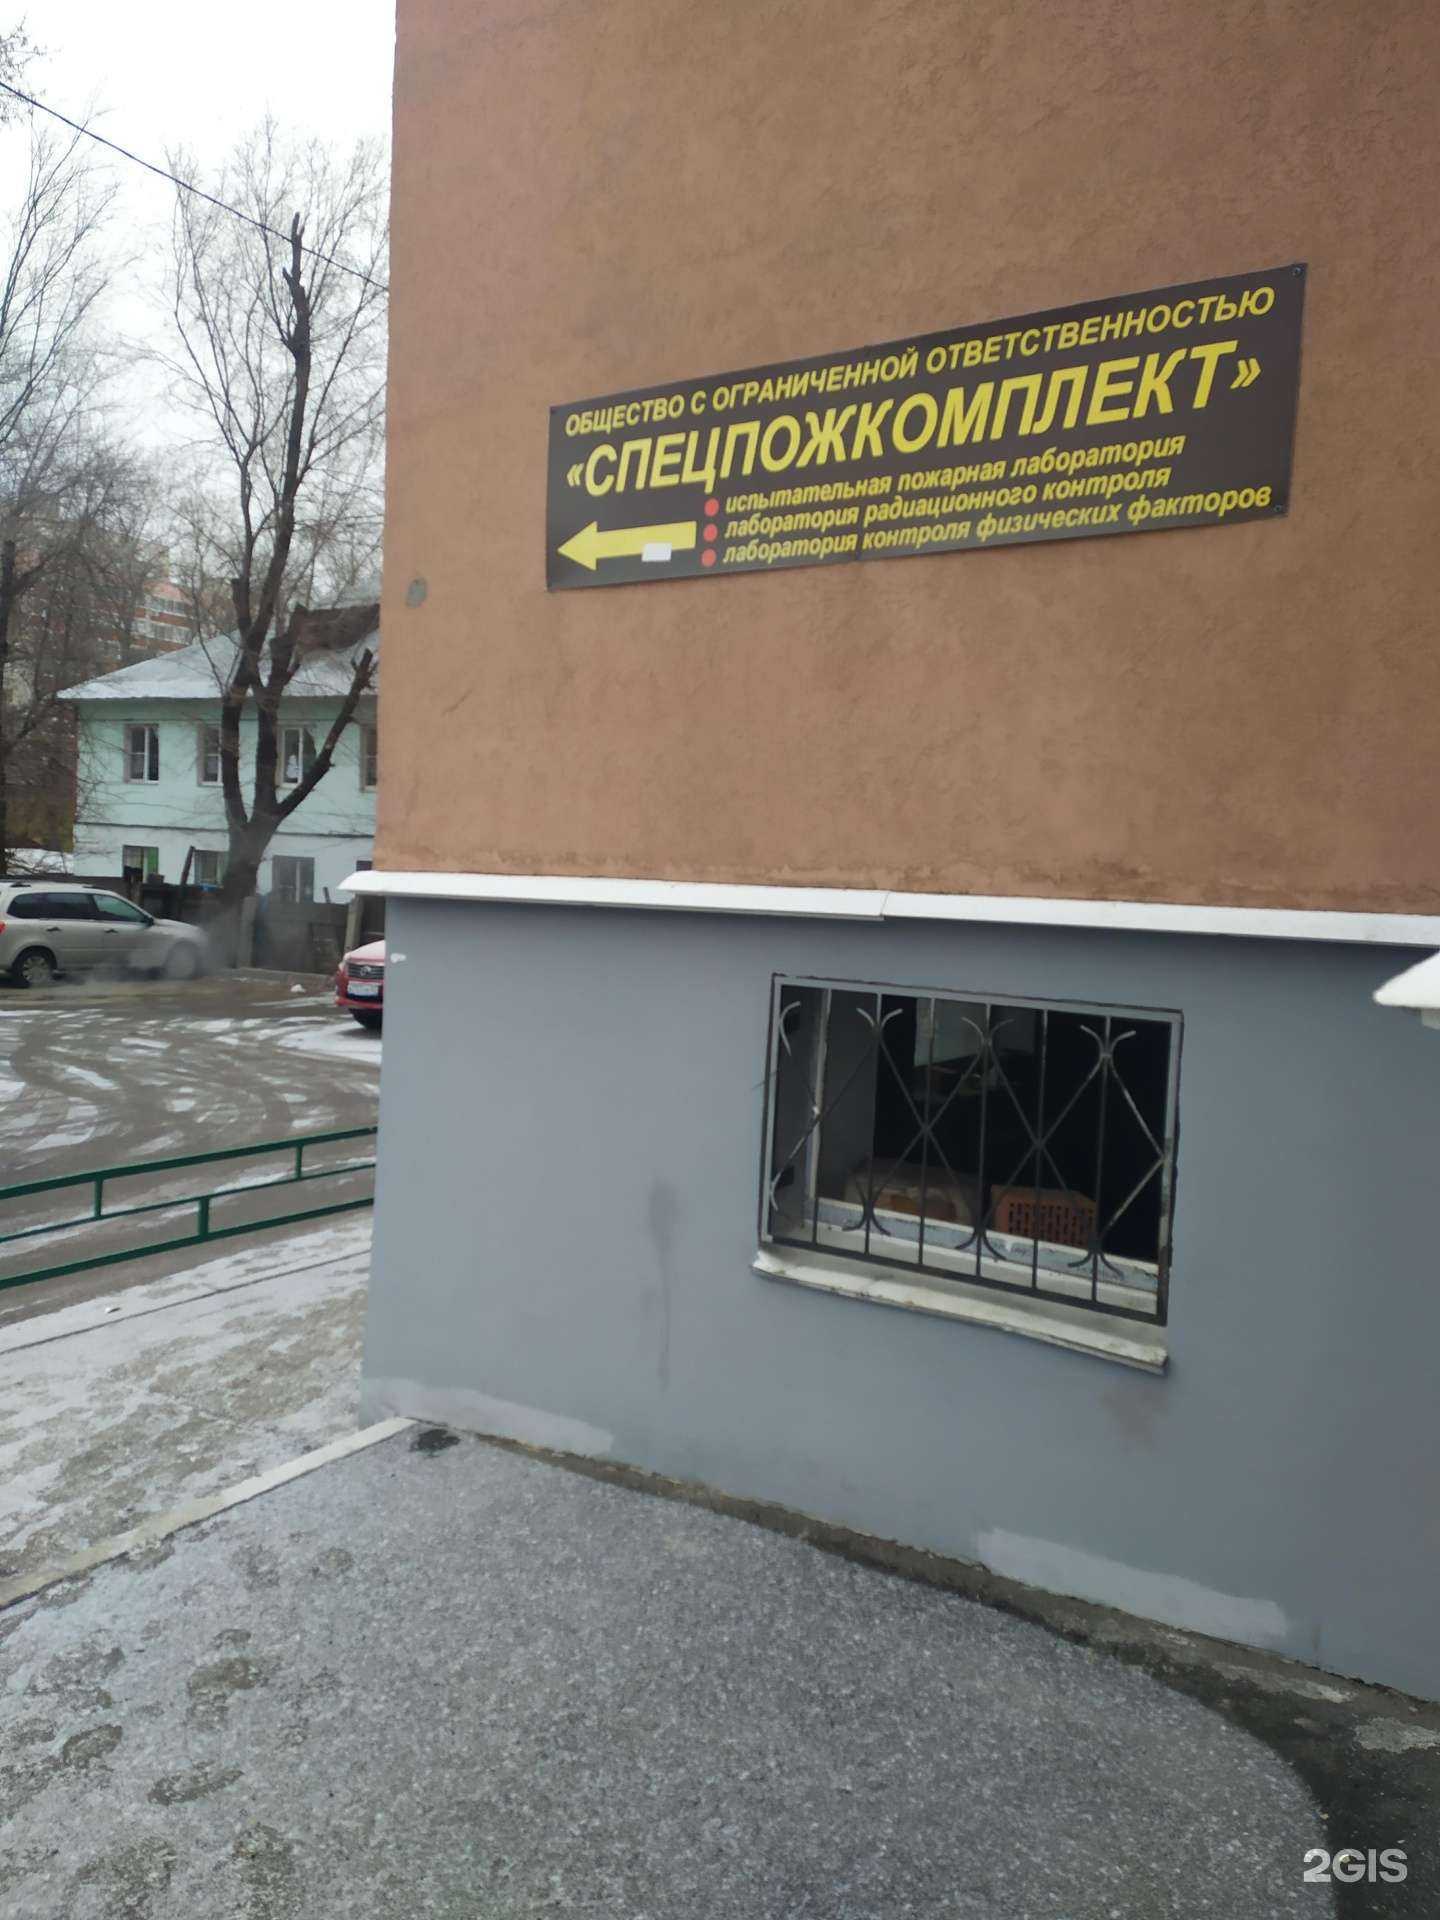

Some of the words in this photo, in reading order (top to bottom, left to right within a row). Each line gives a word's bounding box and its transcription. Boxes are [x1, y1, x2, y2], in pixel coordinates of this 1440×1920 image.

[565, 394, 685, 437] ОБЩЕСТВО
[690, 390, 706, 415] С
[712, 346, 919, 411] ОГРАНИЧЕННОЙ
[926, 286, 1275, 374] ОТВЕТСТВЕННОСТЬЮ
[566, 340, 1262, 496] «СПЕЦПОЖКОМПЛЕКТ»
[724, 506, 859, 539] лаборатория
[863, 485, 1036, 528] радиационного
[1042, 467, 1172, 501] контроля
[725, 475, 892, 514] испытательная
[897, 458, 1006, 491] пожарная
[1010, 435, 1187, 478] лаборатория
[722, 533, 858, 564] лаборатория
[862, 521, 971, 550] контроля
[976, 502, 1122, 542] физических
[1127, 486, 1272, 526] факторов
